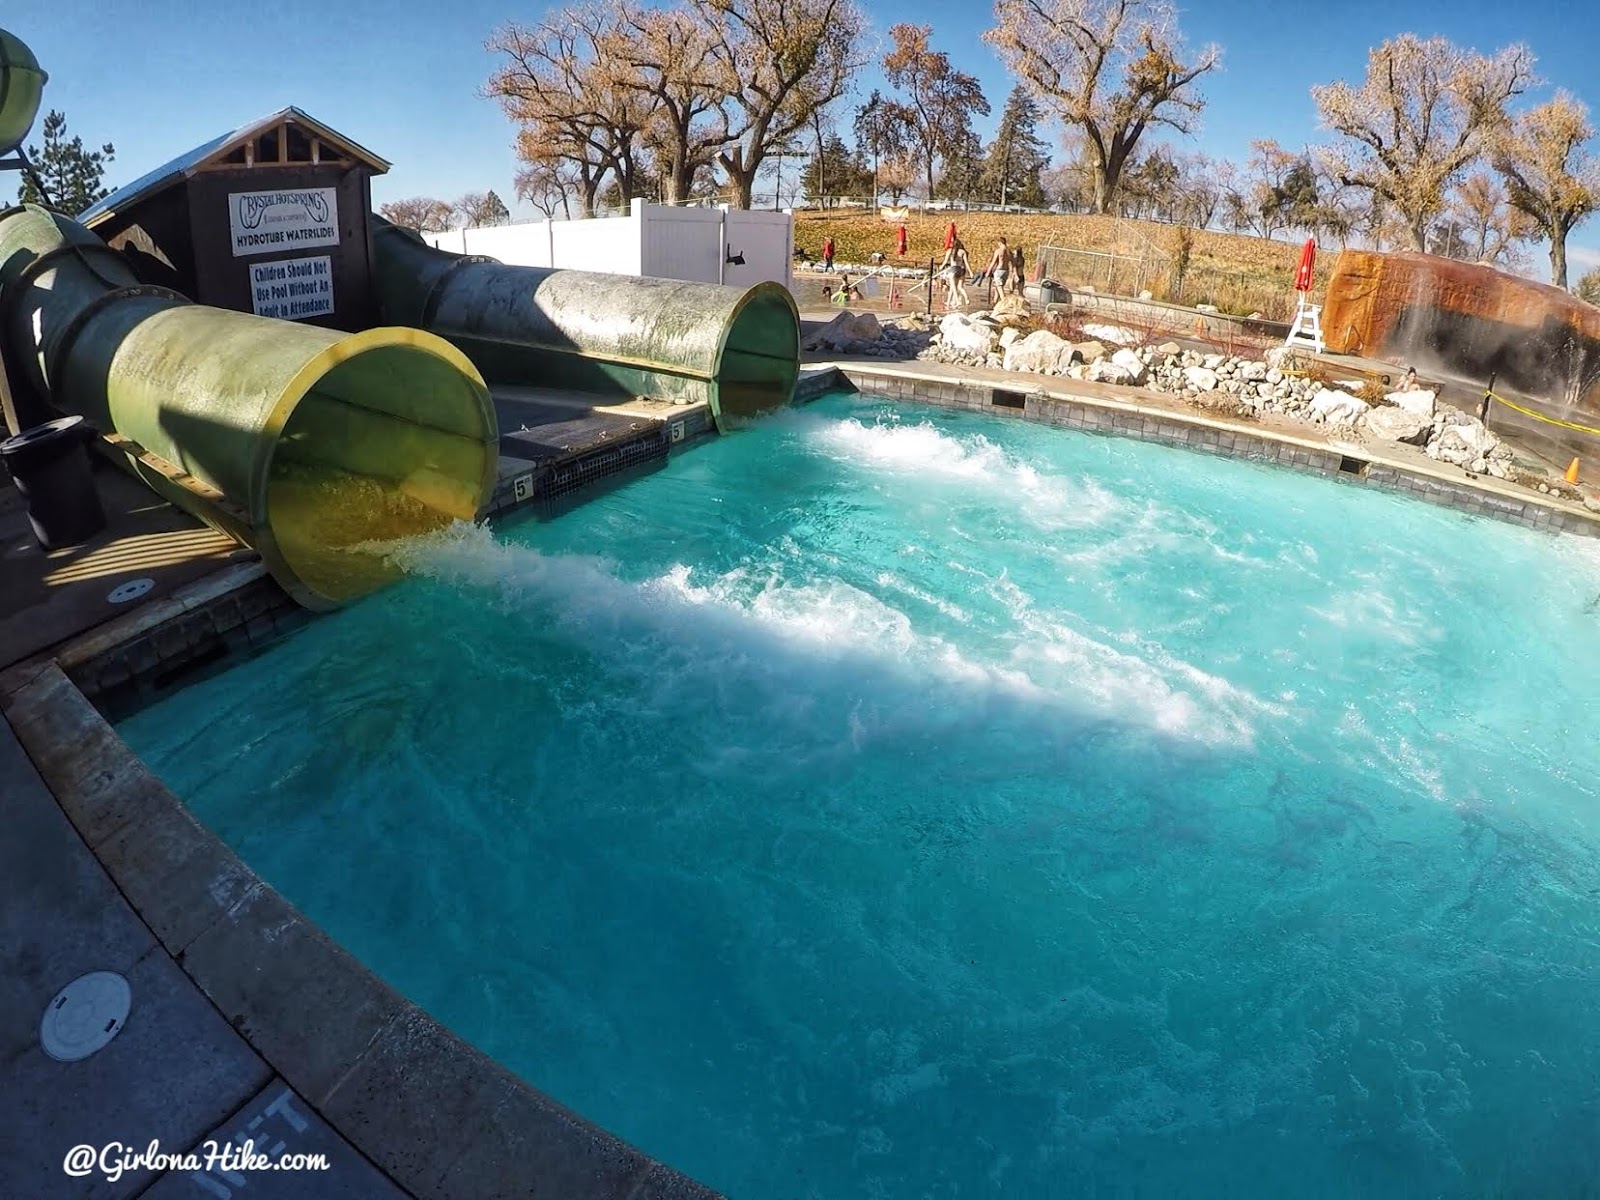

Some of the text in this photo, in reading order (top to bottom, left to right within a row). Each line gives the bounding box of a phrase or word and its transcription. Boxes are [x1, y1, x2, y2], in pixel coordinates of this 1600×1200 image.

[236, 227, 335, 247] HYDROTUBE WATERSLIDES
[255, 261, 327, 282] Children Should Not
[256, 279, 329, 301] Use Pool Without An
[280, 304, 288, 317] In
[290, 299, 330, 315] Attendance
[673, 424, 680, 439] 5
[516, 480, 526, 497] 5
